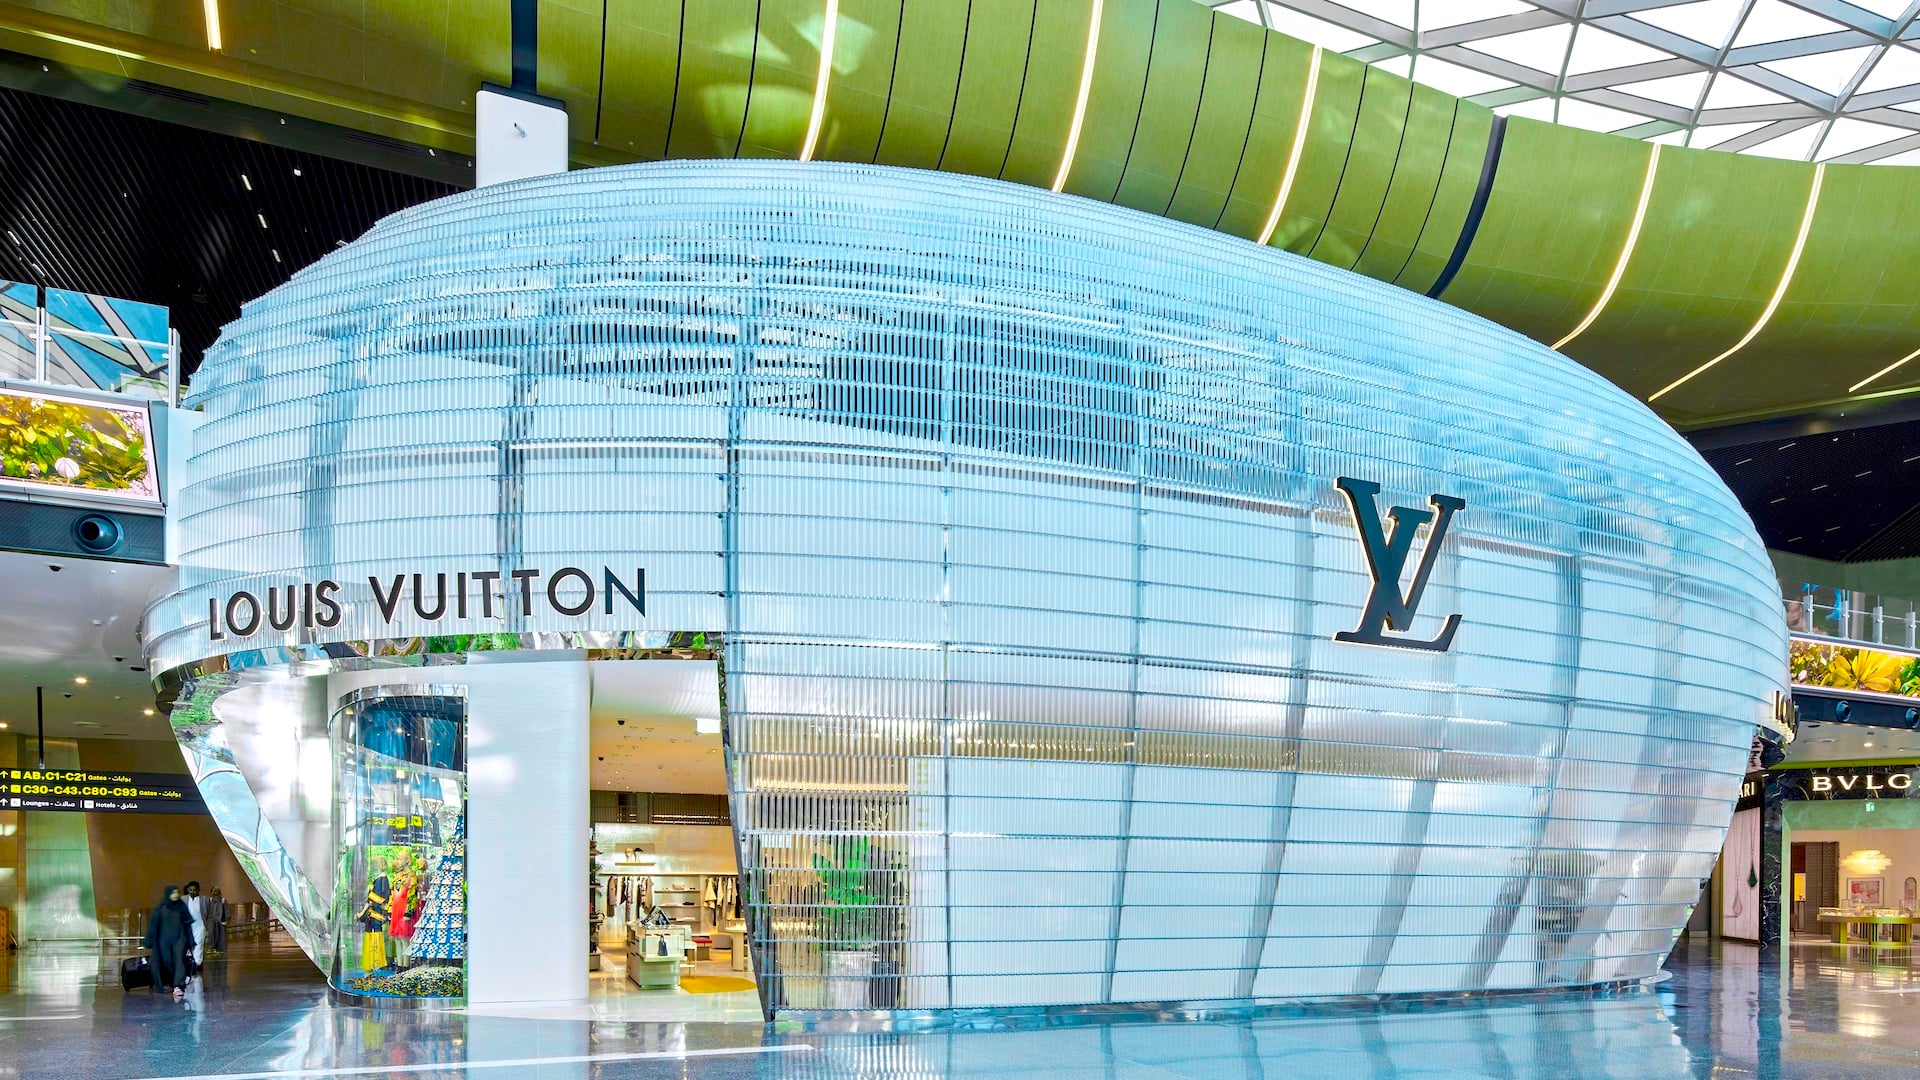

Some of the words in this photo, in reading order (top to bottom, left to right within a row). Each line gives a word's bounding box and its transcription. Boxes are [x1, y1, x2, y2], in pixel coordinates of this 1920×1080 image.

[1333, 476, 1466, 654] LV
[209, 580, 343, 641] LOUIS
[368, 565, 647, 625] VUITTON
[1738, 781, 1755, 799] ARI
[1812, 773, 1920, 792] BVLG
